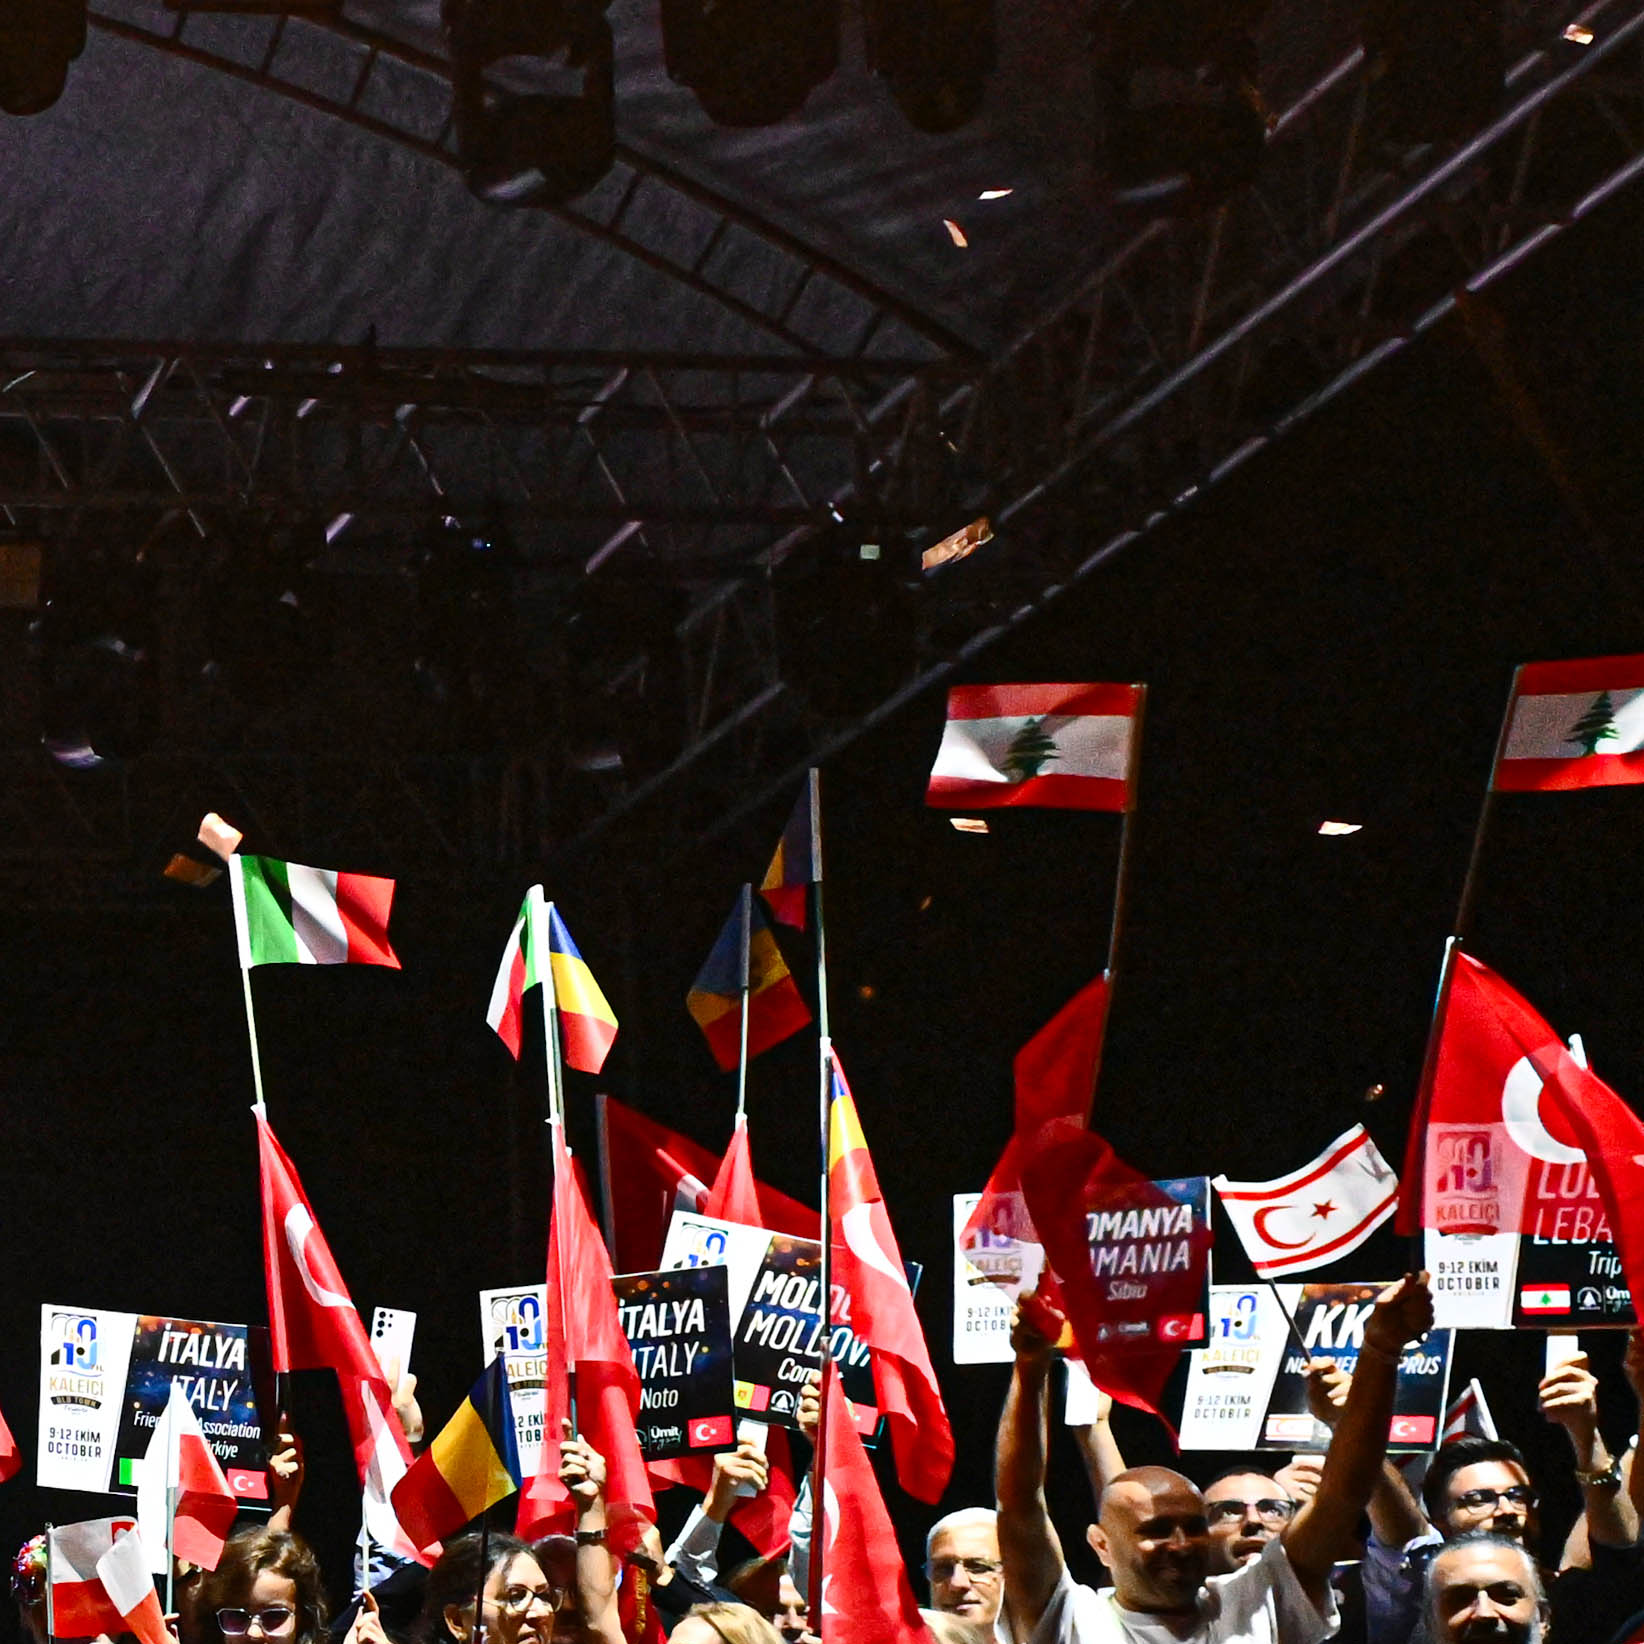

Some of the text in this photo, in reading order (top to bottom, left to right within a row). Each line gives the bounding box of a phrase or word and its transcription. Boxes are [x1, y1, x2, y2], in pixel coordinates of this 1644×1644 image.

[1533, 1207, 1613, 1245] LEBA
[1438, 1258, 1499, 1274] 9-12 EKİM
[1438, 1277, 1500, 1290] OCTOBER
[966, 1319, 1006, 1332] OCTOB
[158, 1323, 246, 1371] İTALYA
[640, 1389, 678, 1410] Noto
[49, 1427, 72, 1440] 9-12
[48, 1441, 102, 1458] OCTOBER
